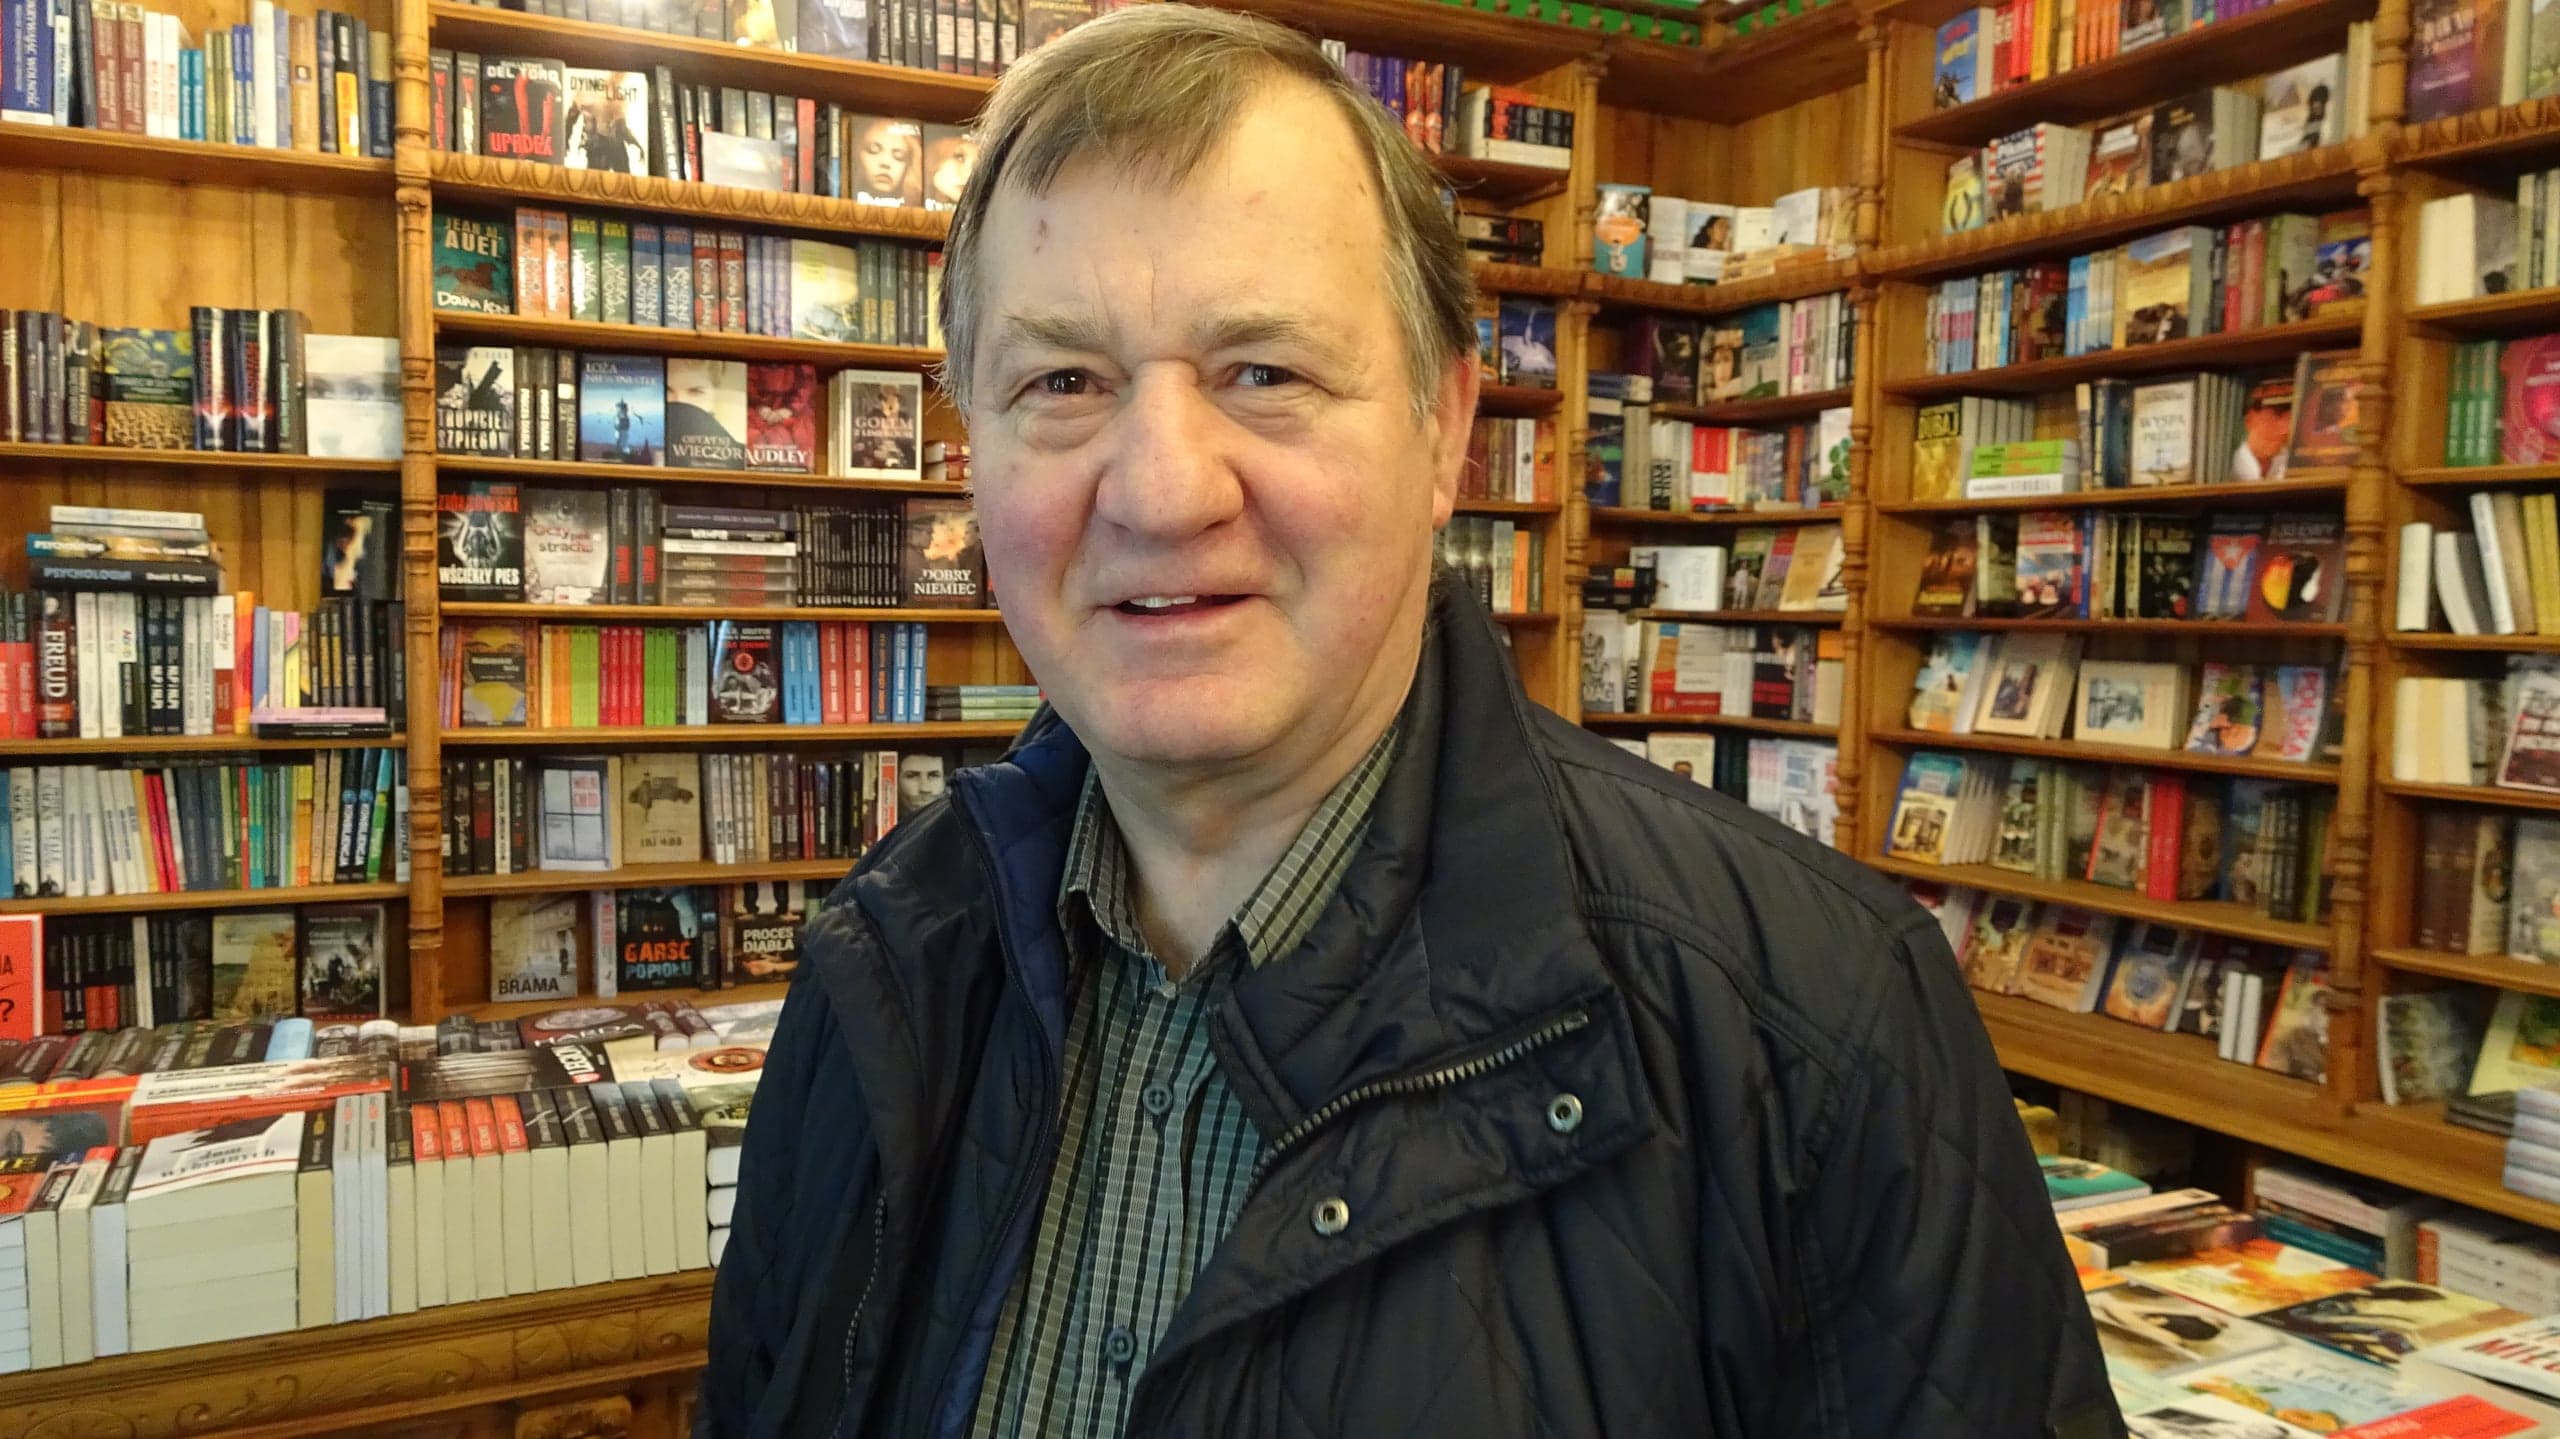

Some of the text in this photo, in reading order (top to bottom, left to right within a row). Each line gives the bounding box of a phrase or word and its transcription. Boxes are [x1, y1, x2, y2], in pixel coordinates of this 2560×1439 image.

[570, 76, 638, 102] DYING LIGHT
[746, 448, 808, 465] AUDLEY
[438, 563, 520, 585] WŚCIEKŁY PIES
[920, 568, 972, 582] DOBRY
[913, 582, 977, 595] NIEMIEC
[44, 629, 68, 699] FREUD
[743, 926, 795, 941] PROCES
[743, 938, 795, 953] DIABŁA
[625, 960, 693, 981] POPIOŁU
[498, 977, 560, 995] BRAMA
